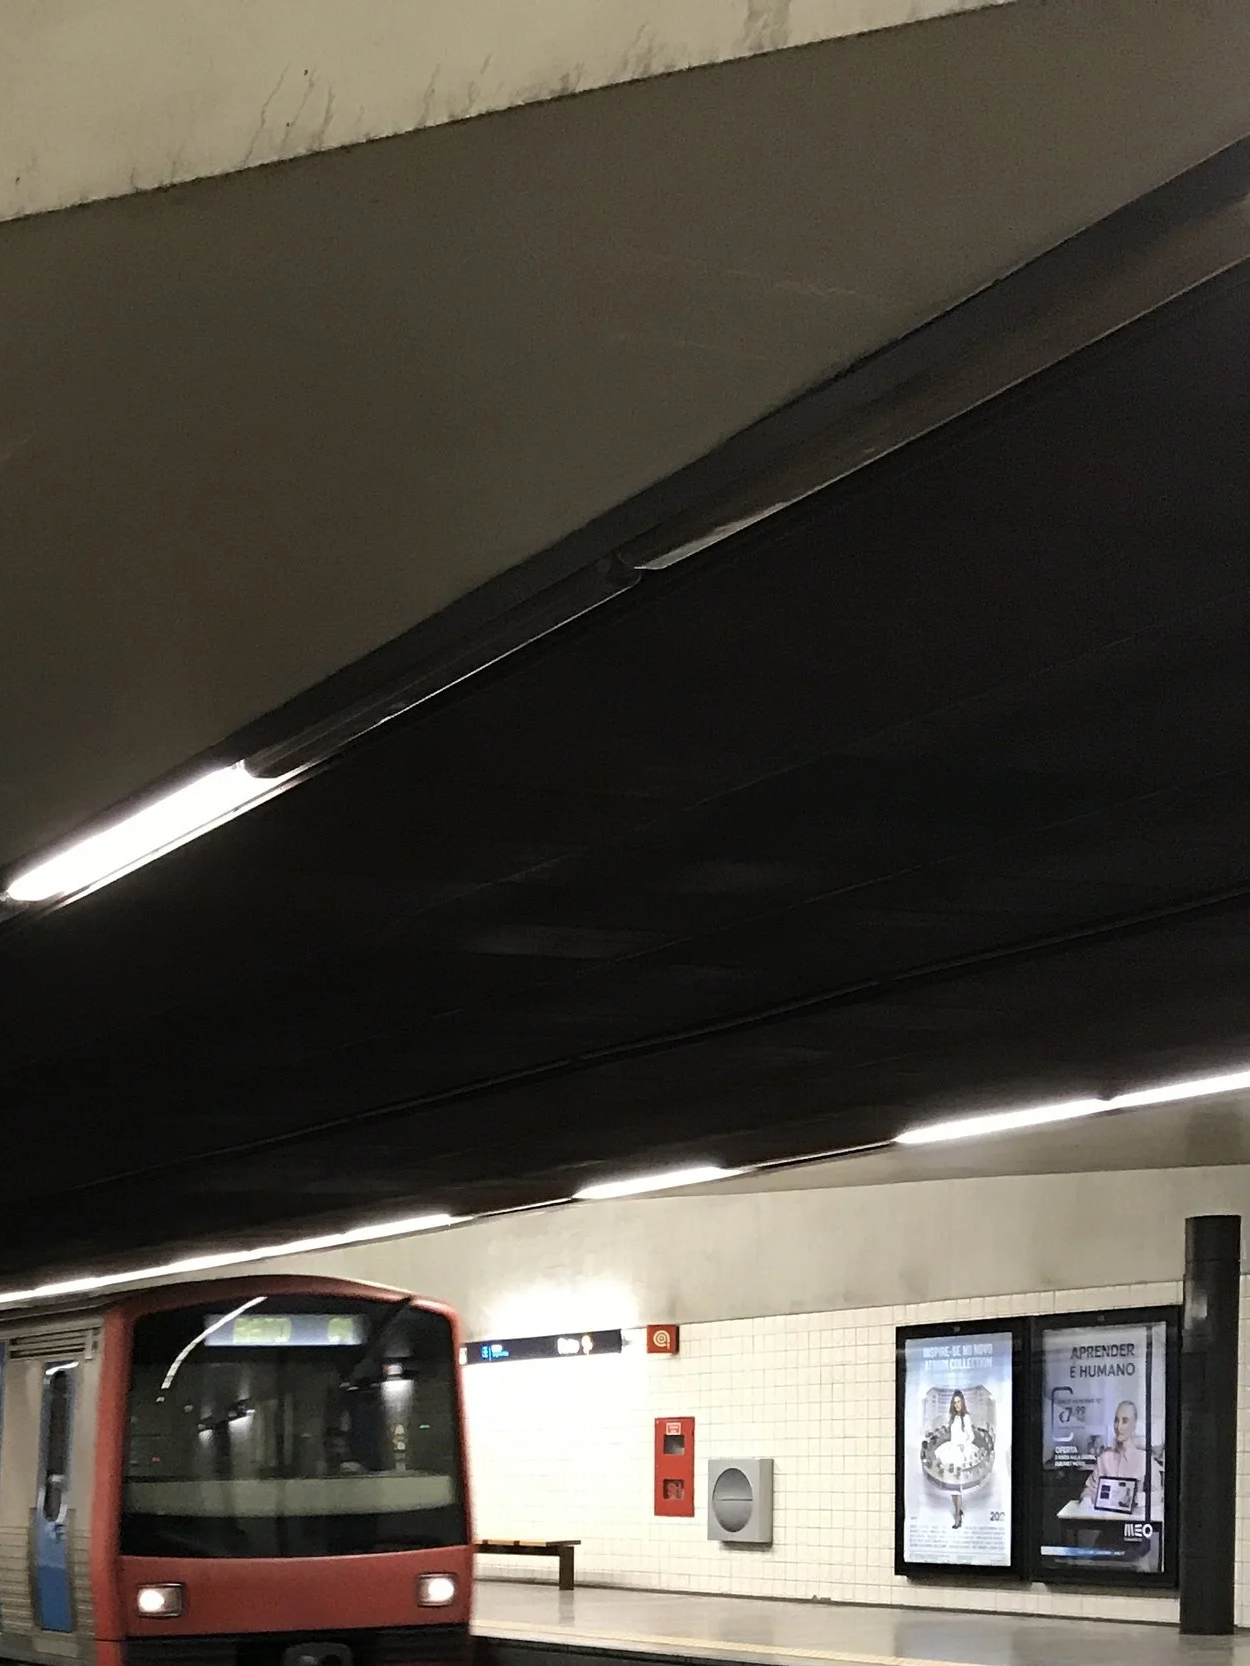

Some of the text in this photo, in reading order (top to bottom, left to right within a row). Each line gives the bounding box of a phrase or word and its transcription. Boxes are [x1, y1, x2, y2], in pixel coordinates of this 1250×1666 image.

[1071, 1343, 1135, 1359] APRENDER
[1079, 1362, 1136, 1378] HUMANO
[1123, 1523, 1153, 1538] MEO
